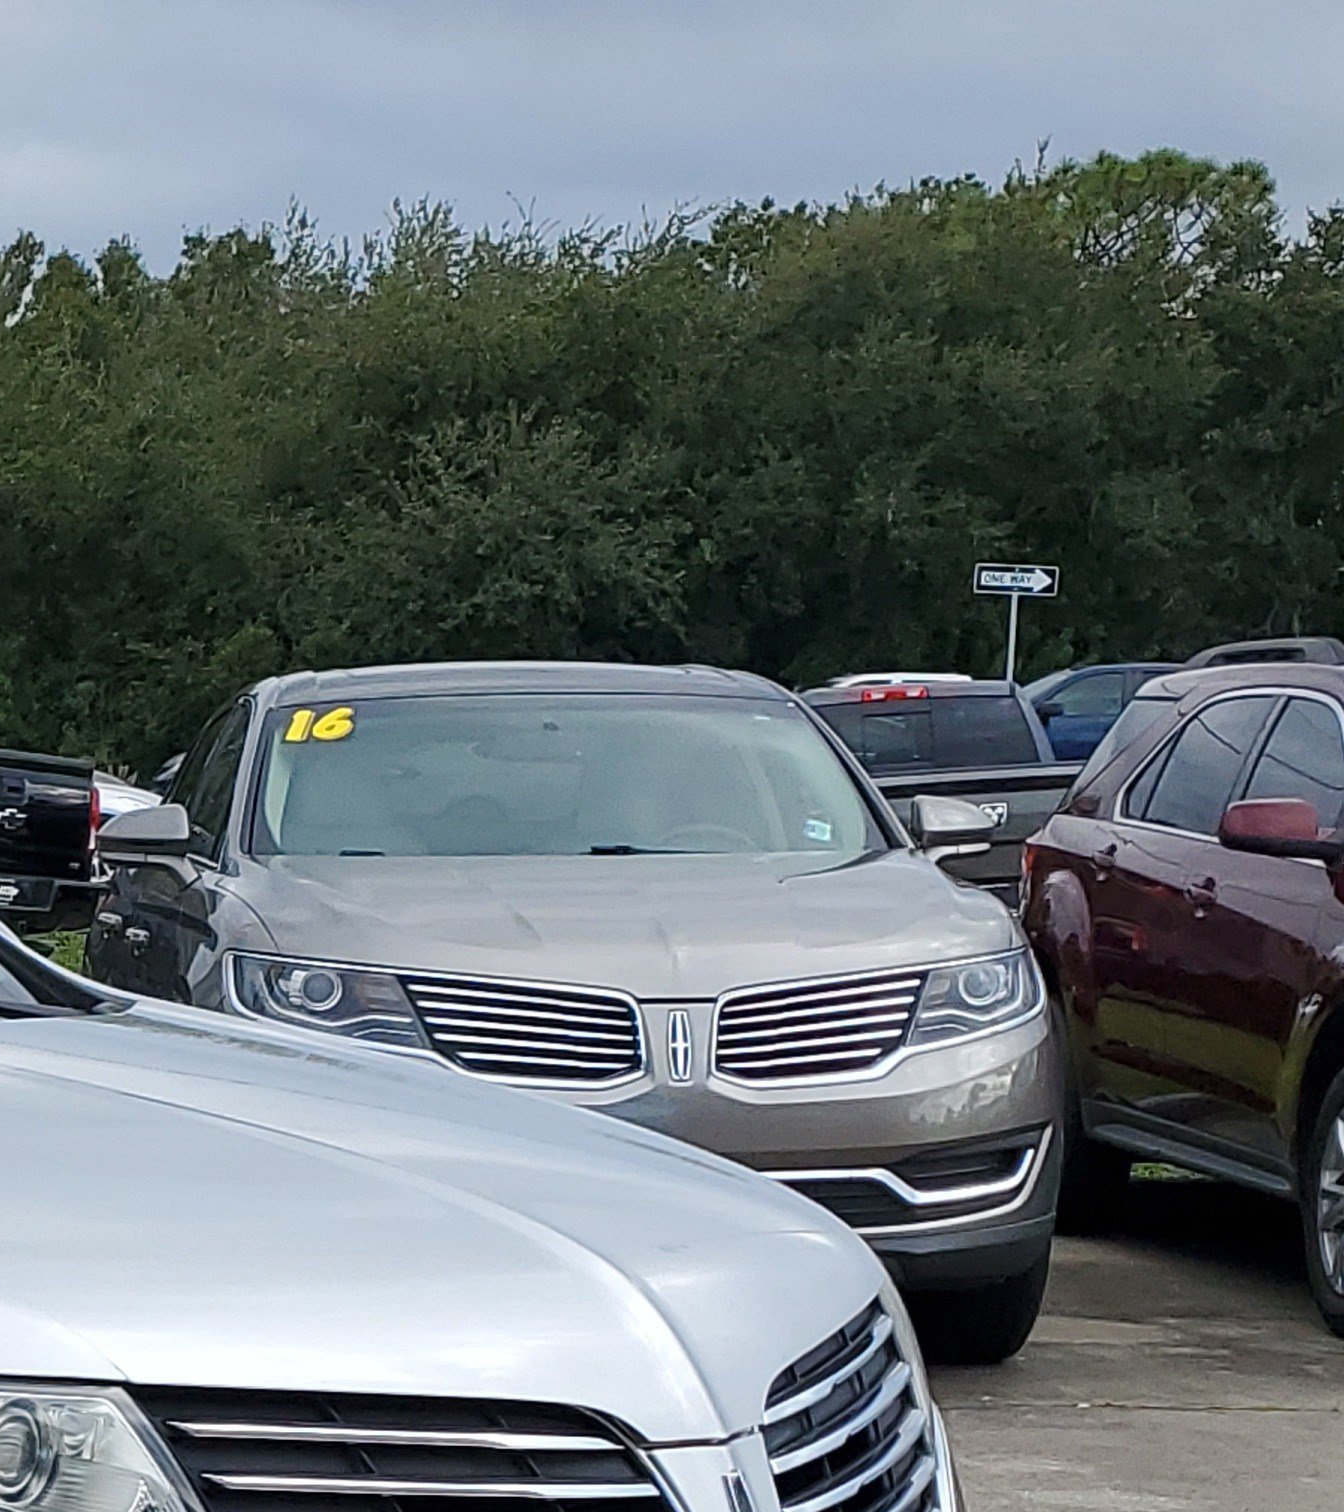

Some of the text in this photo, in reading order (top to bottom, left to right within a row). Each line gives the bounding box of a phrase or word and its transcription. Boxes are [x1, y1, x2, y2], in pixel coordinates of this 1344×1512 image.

[983, 572, 1032, 585] ONE WAY
[284, 706, 354, 742] 16
